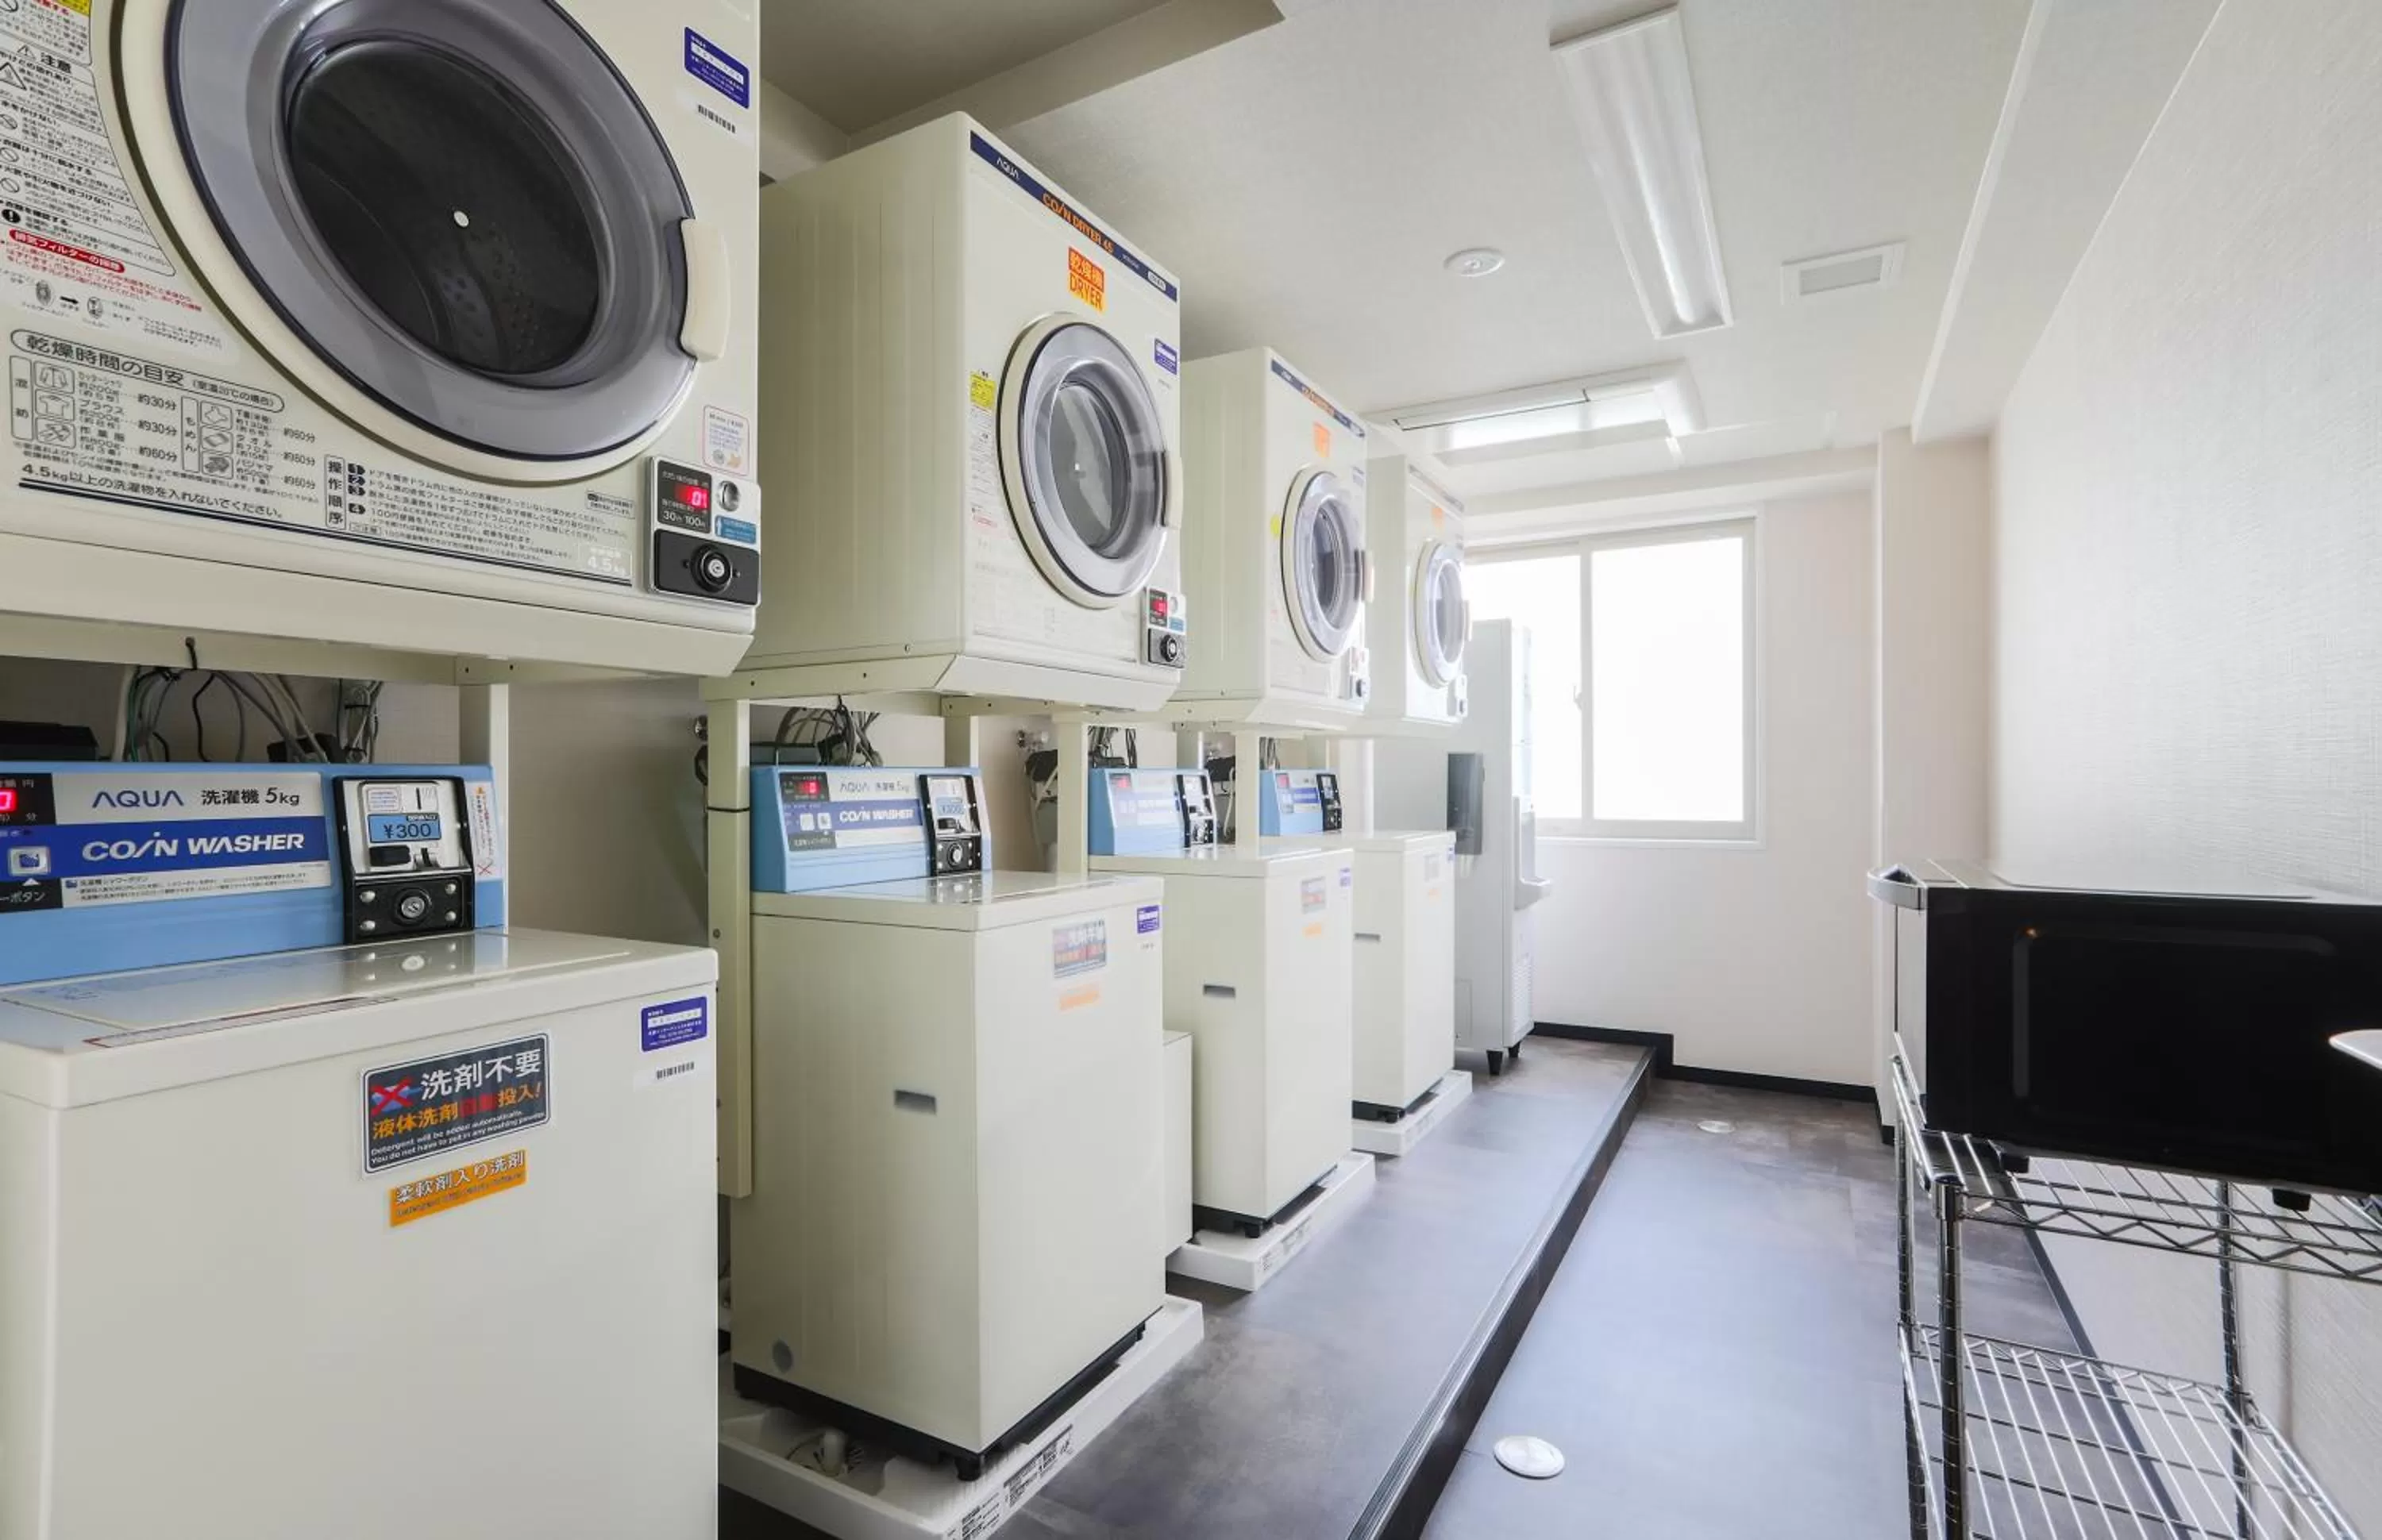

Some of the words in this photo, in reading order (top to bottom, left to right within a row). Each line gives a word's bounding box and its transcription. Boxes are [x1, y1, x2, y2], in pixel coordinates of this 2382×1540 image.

[1070, 273, 1102, 310] DRYER
[26, 333, 184, 387] 乾燥時間の目安
[138, 393, 177, 411] 約30分
[138, 419, 177, 437] 約30分
[92, 790, 183, 809] AQUA
[202, 789, 260, 805] 洗濯機
[265, 787, 300, 806] 5kg
[839, 806, 870, 822] COIN
[384, 823, 431, 839] ¥300
[82, 831, 179, 861] COIN
[187, 834, 305, 855] WASHER
[421, 1049, 542, 1101] 洗剤不要
[395, 1151, 523, 1205] 柔軟剤入り洗剤
